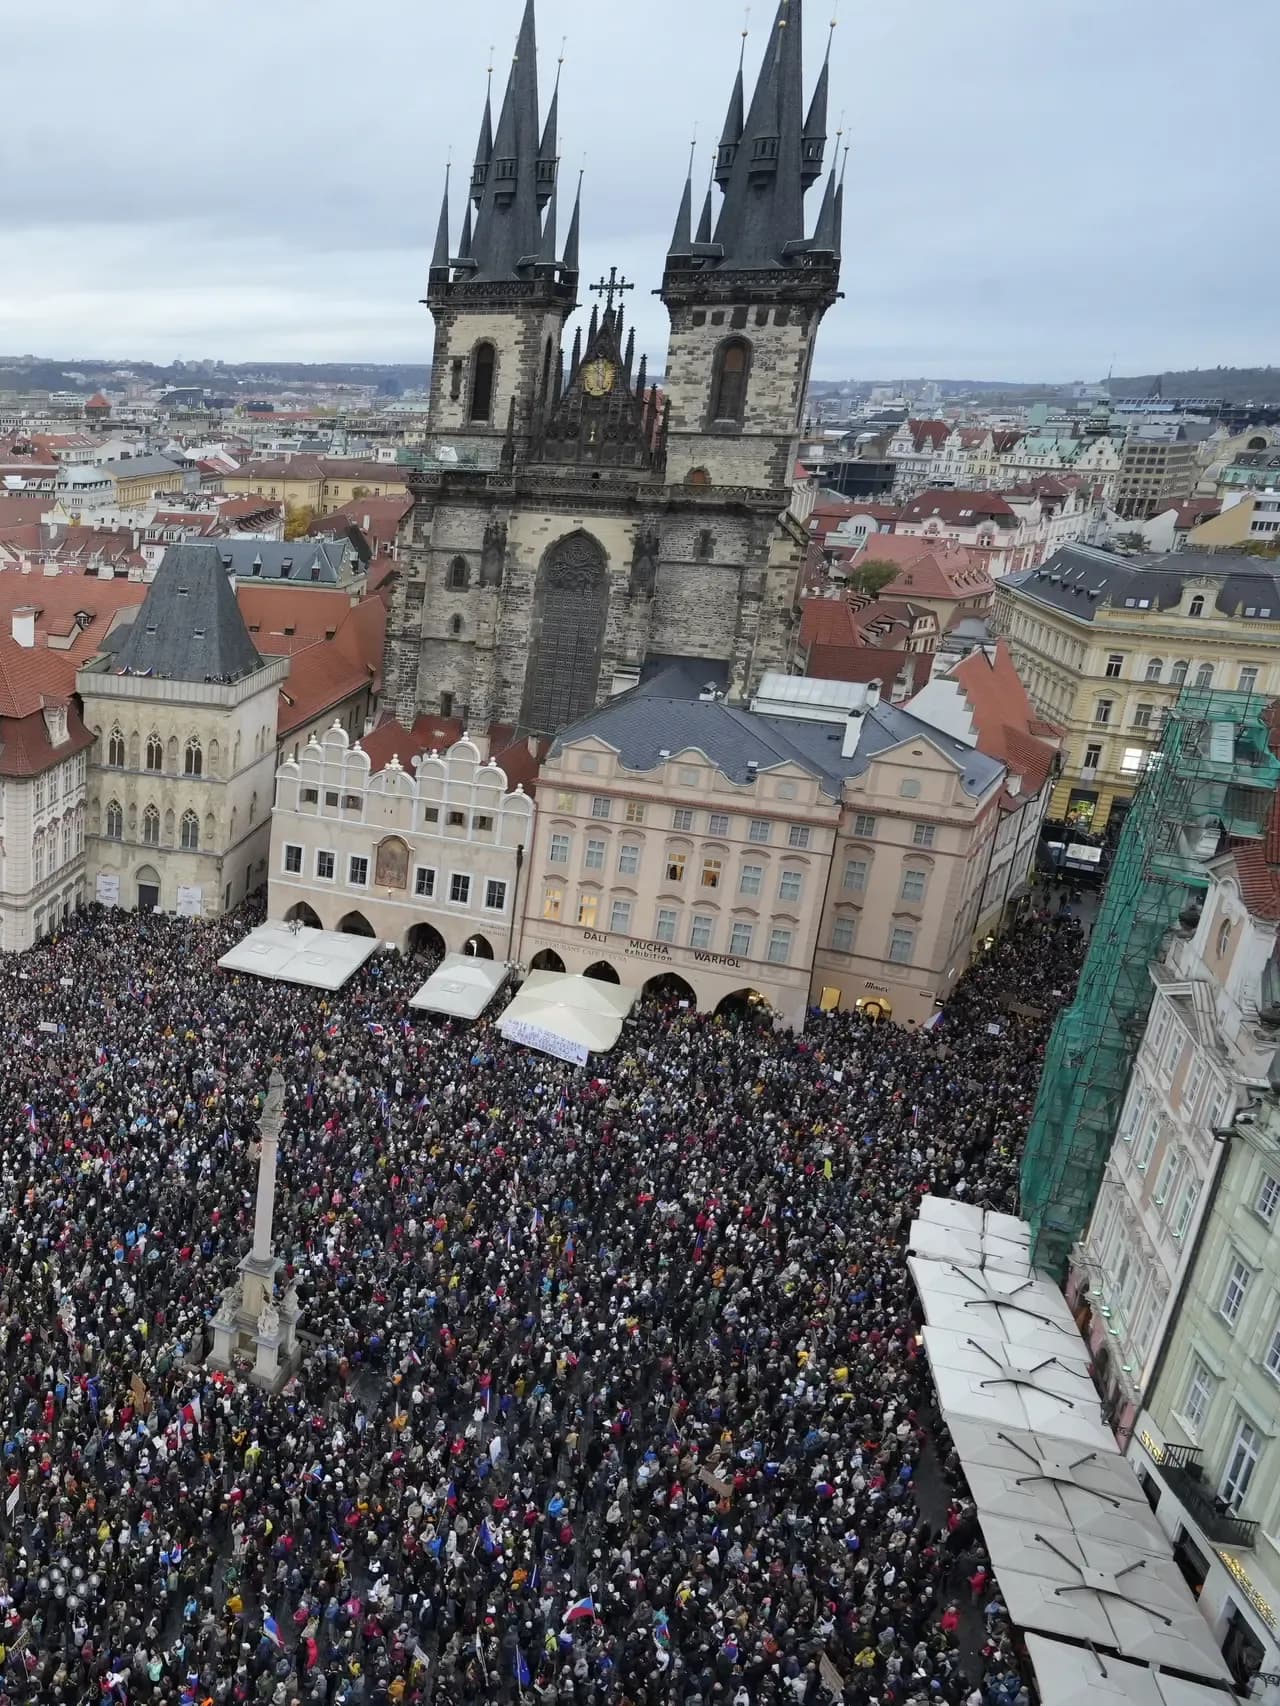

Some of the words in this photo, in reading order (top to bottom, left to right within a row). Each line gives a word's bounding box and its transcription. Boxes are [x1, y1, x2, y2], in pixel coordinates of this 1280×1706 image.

[583, 931, 607, 943] DALI
[630, 939, 669, 954] MUCHA
[624, 948, 672, 961] exhibition
[694, 951, 741, 968] WARHOL
